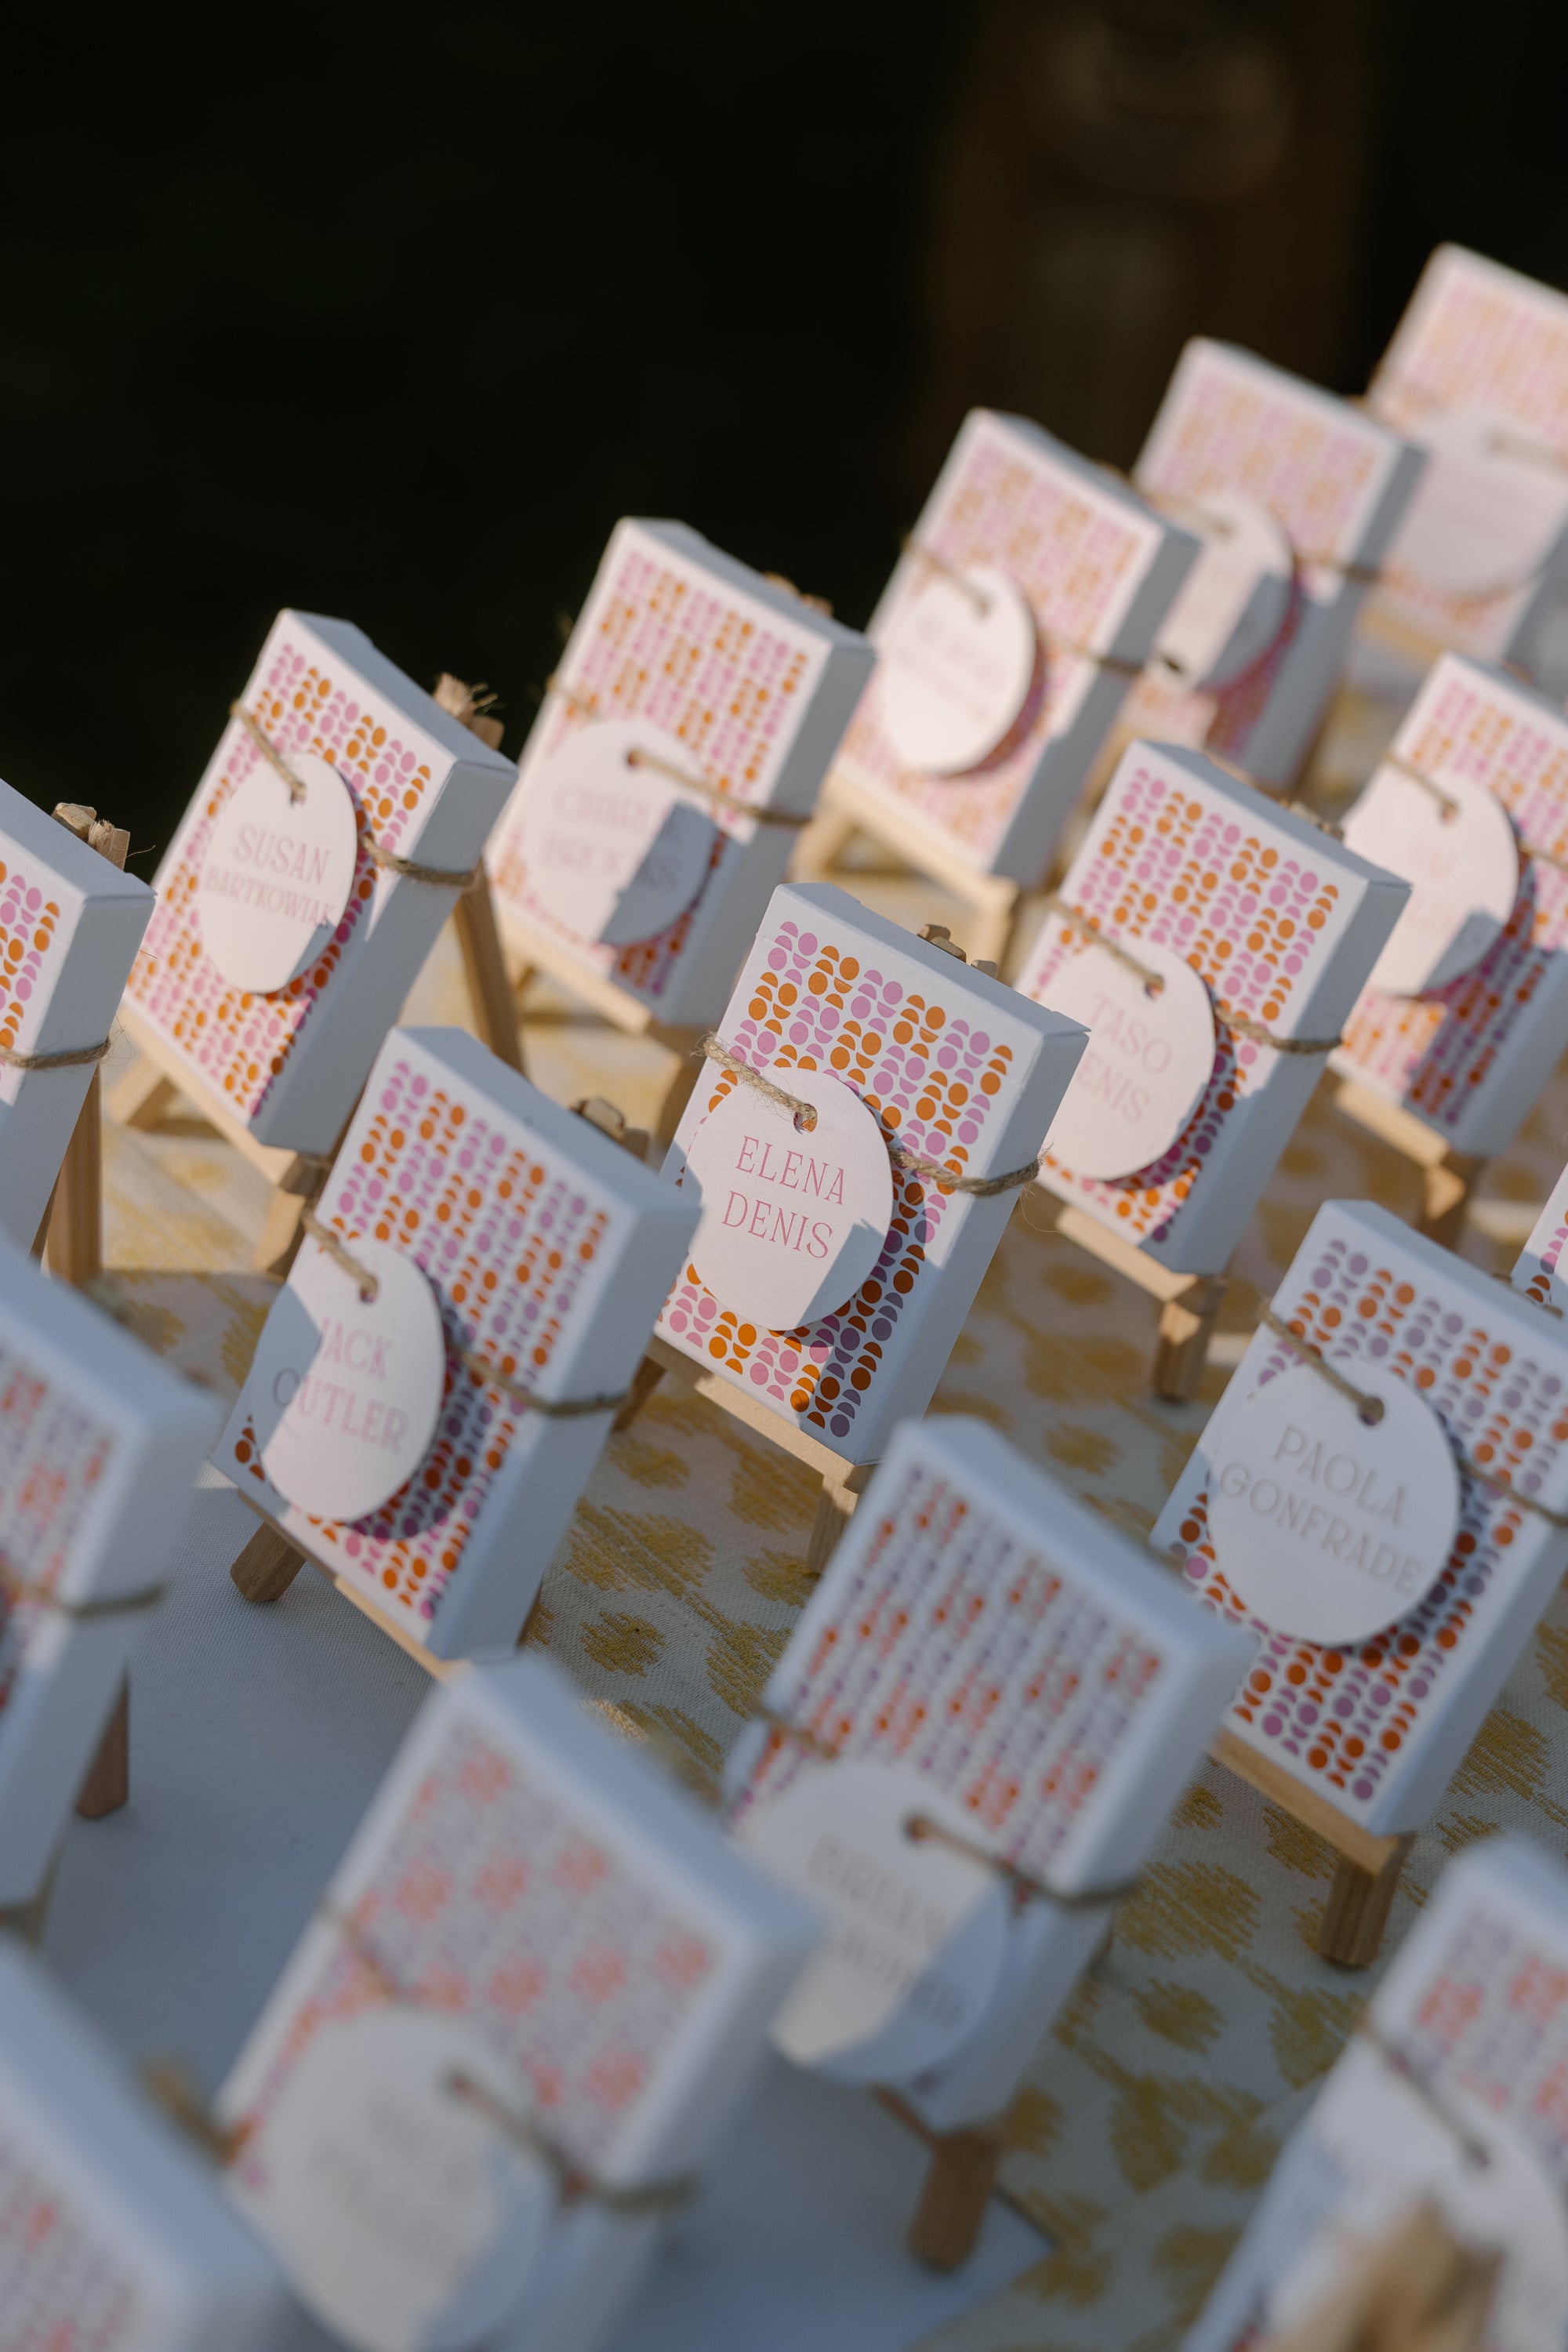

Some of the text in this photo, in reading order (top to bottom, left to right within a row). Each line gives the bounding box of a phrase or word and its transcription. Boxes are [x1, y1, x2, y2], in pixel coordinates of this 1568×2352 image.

[233, 823, 331, 886] SUSAN
[1088, 991, 1173, 1075] TASO
[1075, 1051, 1151, 1124] ENIS
[735, 1135, 844, 1206] ELENA
[721, 1190, 833, 1258] DENIS
[1273, 1425, 1406, 1526] PAOLA
[1219, 1461, 1427, 1595] GONFRADE
